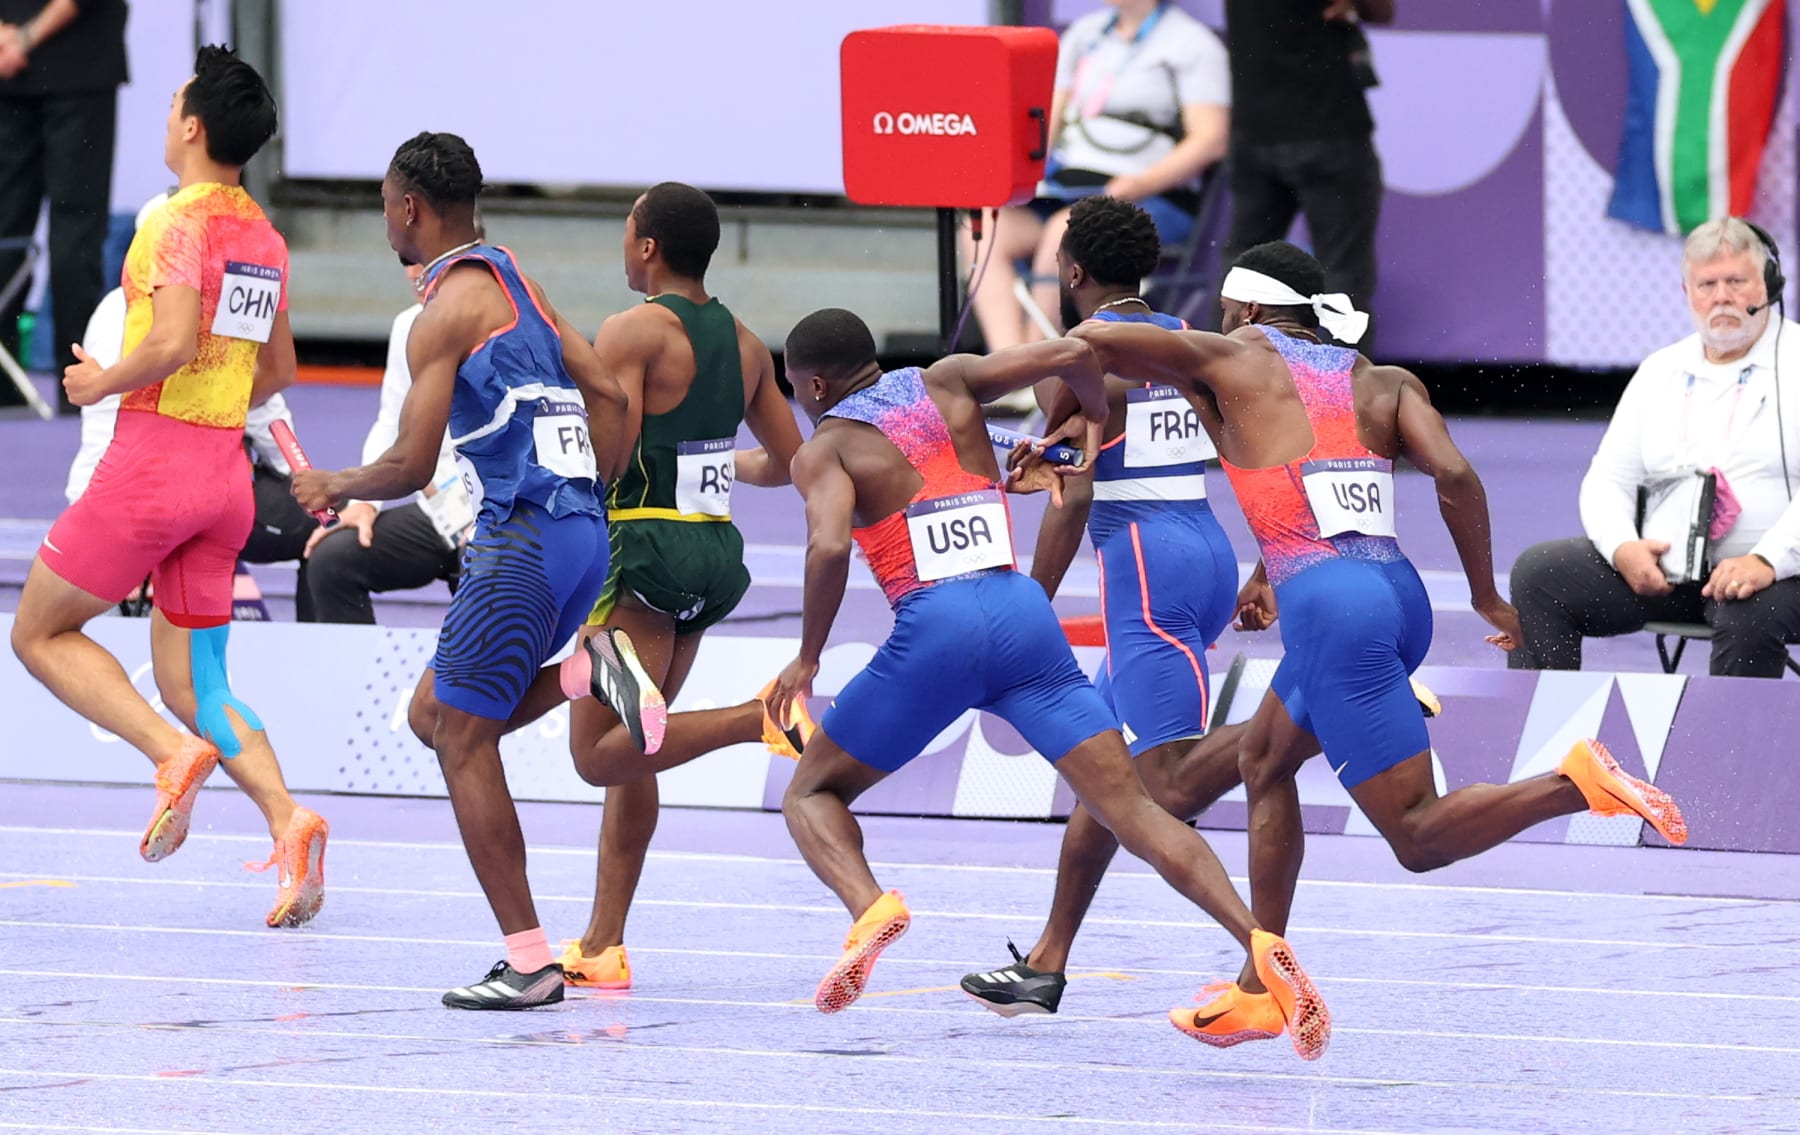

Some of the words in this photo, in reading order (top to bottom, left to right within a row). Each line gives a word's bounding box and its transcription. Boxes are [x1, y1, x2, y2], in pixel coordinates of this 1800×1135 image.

[897, 112, 977, 136] OMEGA
[229, 286, 278, 320] CHN
[558, 425, 589, 456] FR
[1150, 408, 1200, 442] FRA
[700, 462, 733, 494] RS
[1327, 460, 1352, 469] PARIS
[934, 497, 960, 510] PARIS
[961, 494, 984, 505] 2024
[1331, 482, 1382, 514] USA
[927, 515, 993, 555] USA
